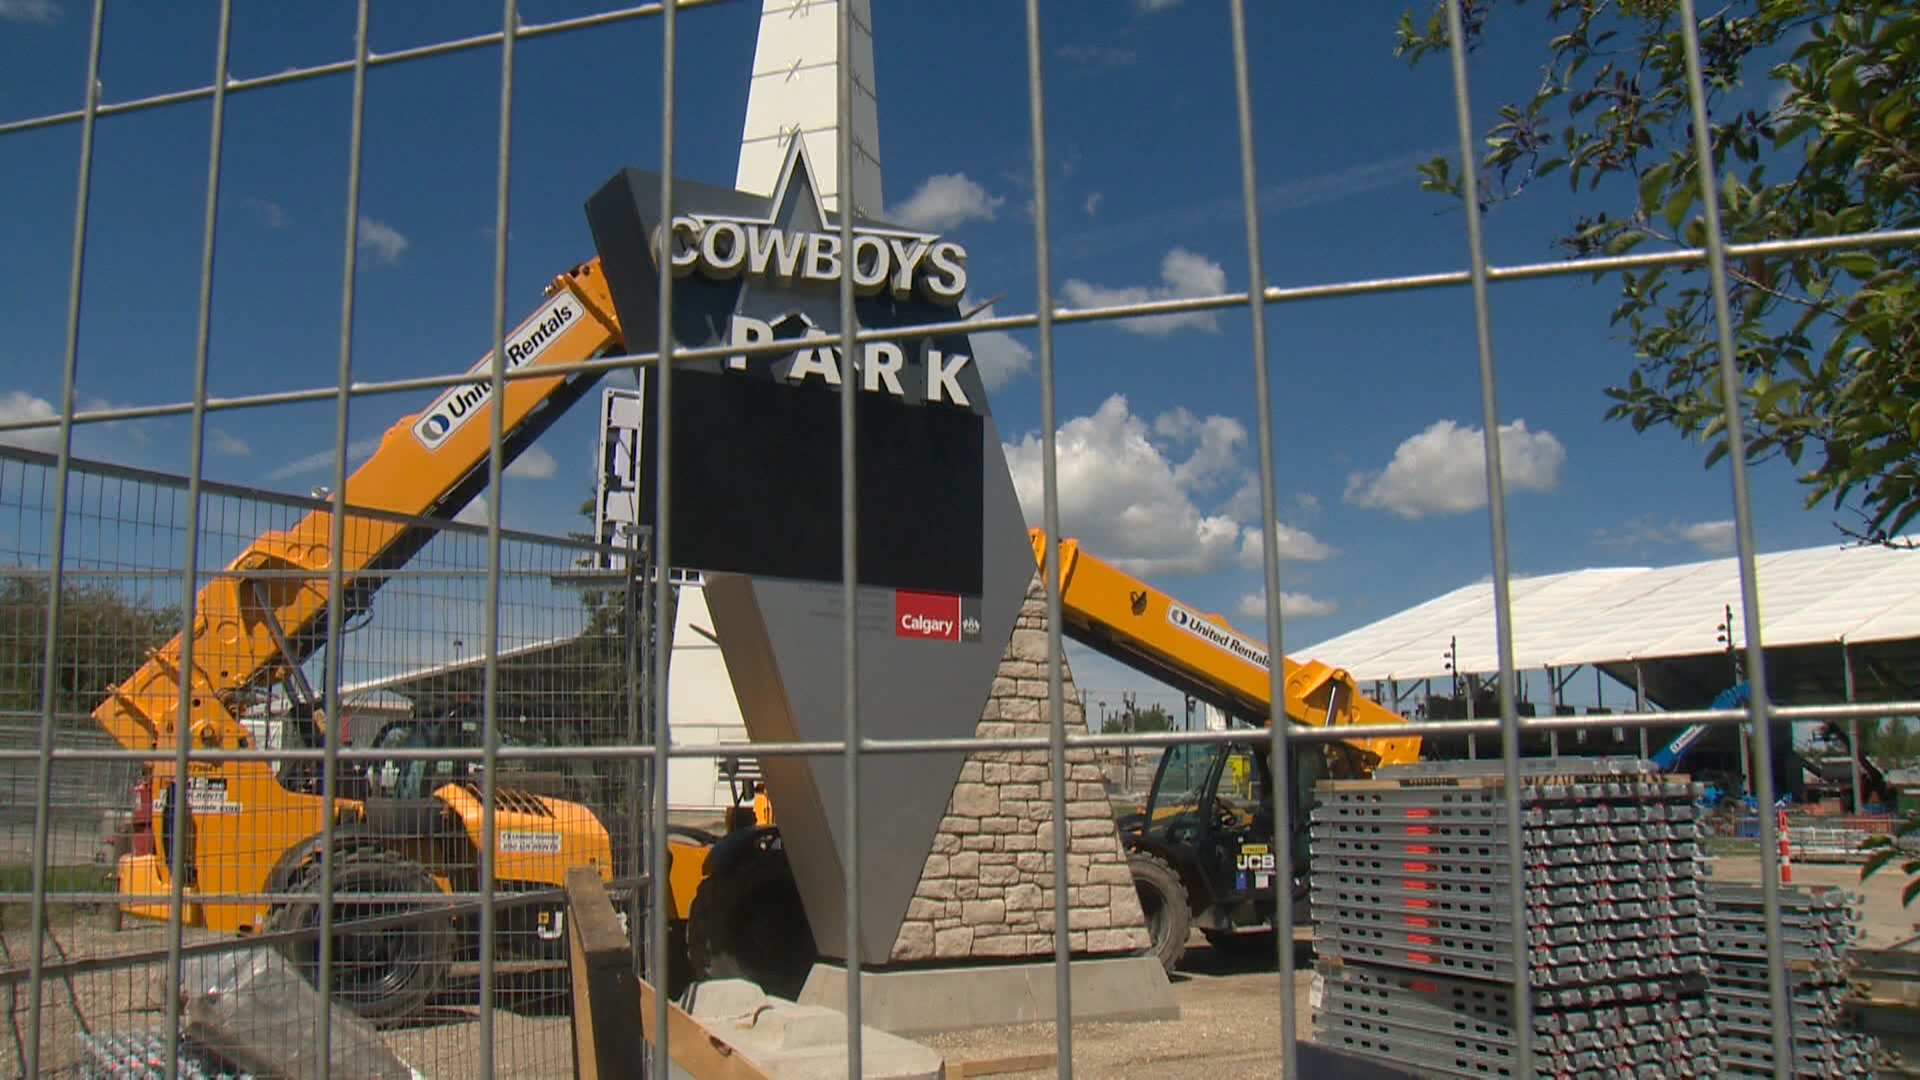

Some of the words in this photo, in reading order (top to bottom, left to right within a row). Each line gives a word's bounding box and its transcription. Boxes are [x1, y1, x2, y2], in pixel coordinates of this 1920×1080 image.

[656, 216, 968, 296] COWBOYS
[507, 304, 573, 366] Rentals
[730, 314, 971, 407] PARK
[901, 614, 953, 636] Calgary
[1189, 618, 1230, 647] United
[1230, 639, 1271, 668] Rentals
[1237, 854, 1275, 870] JCB
